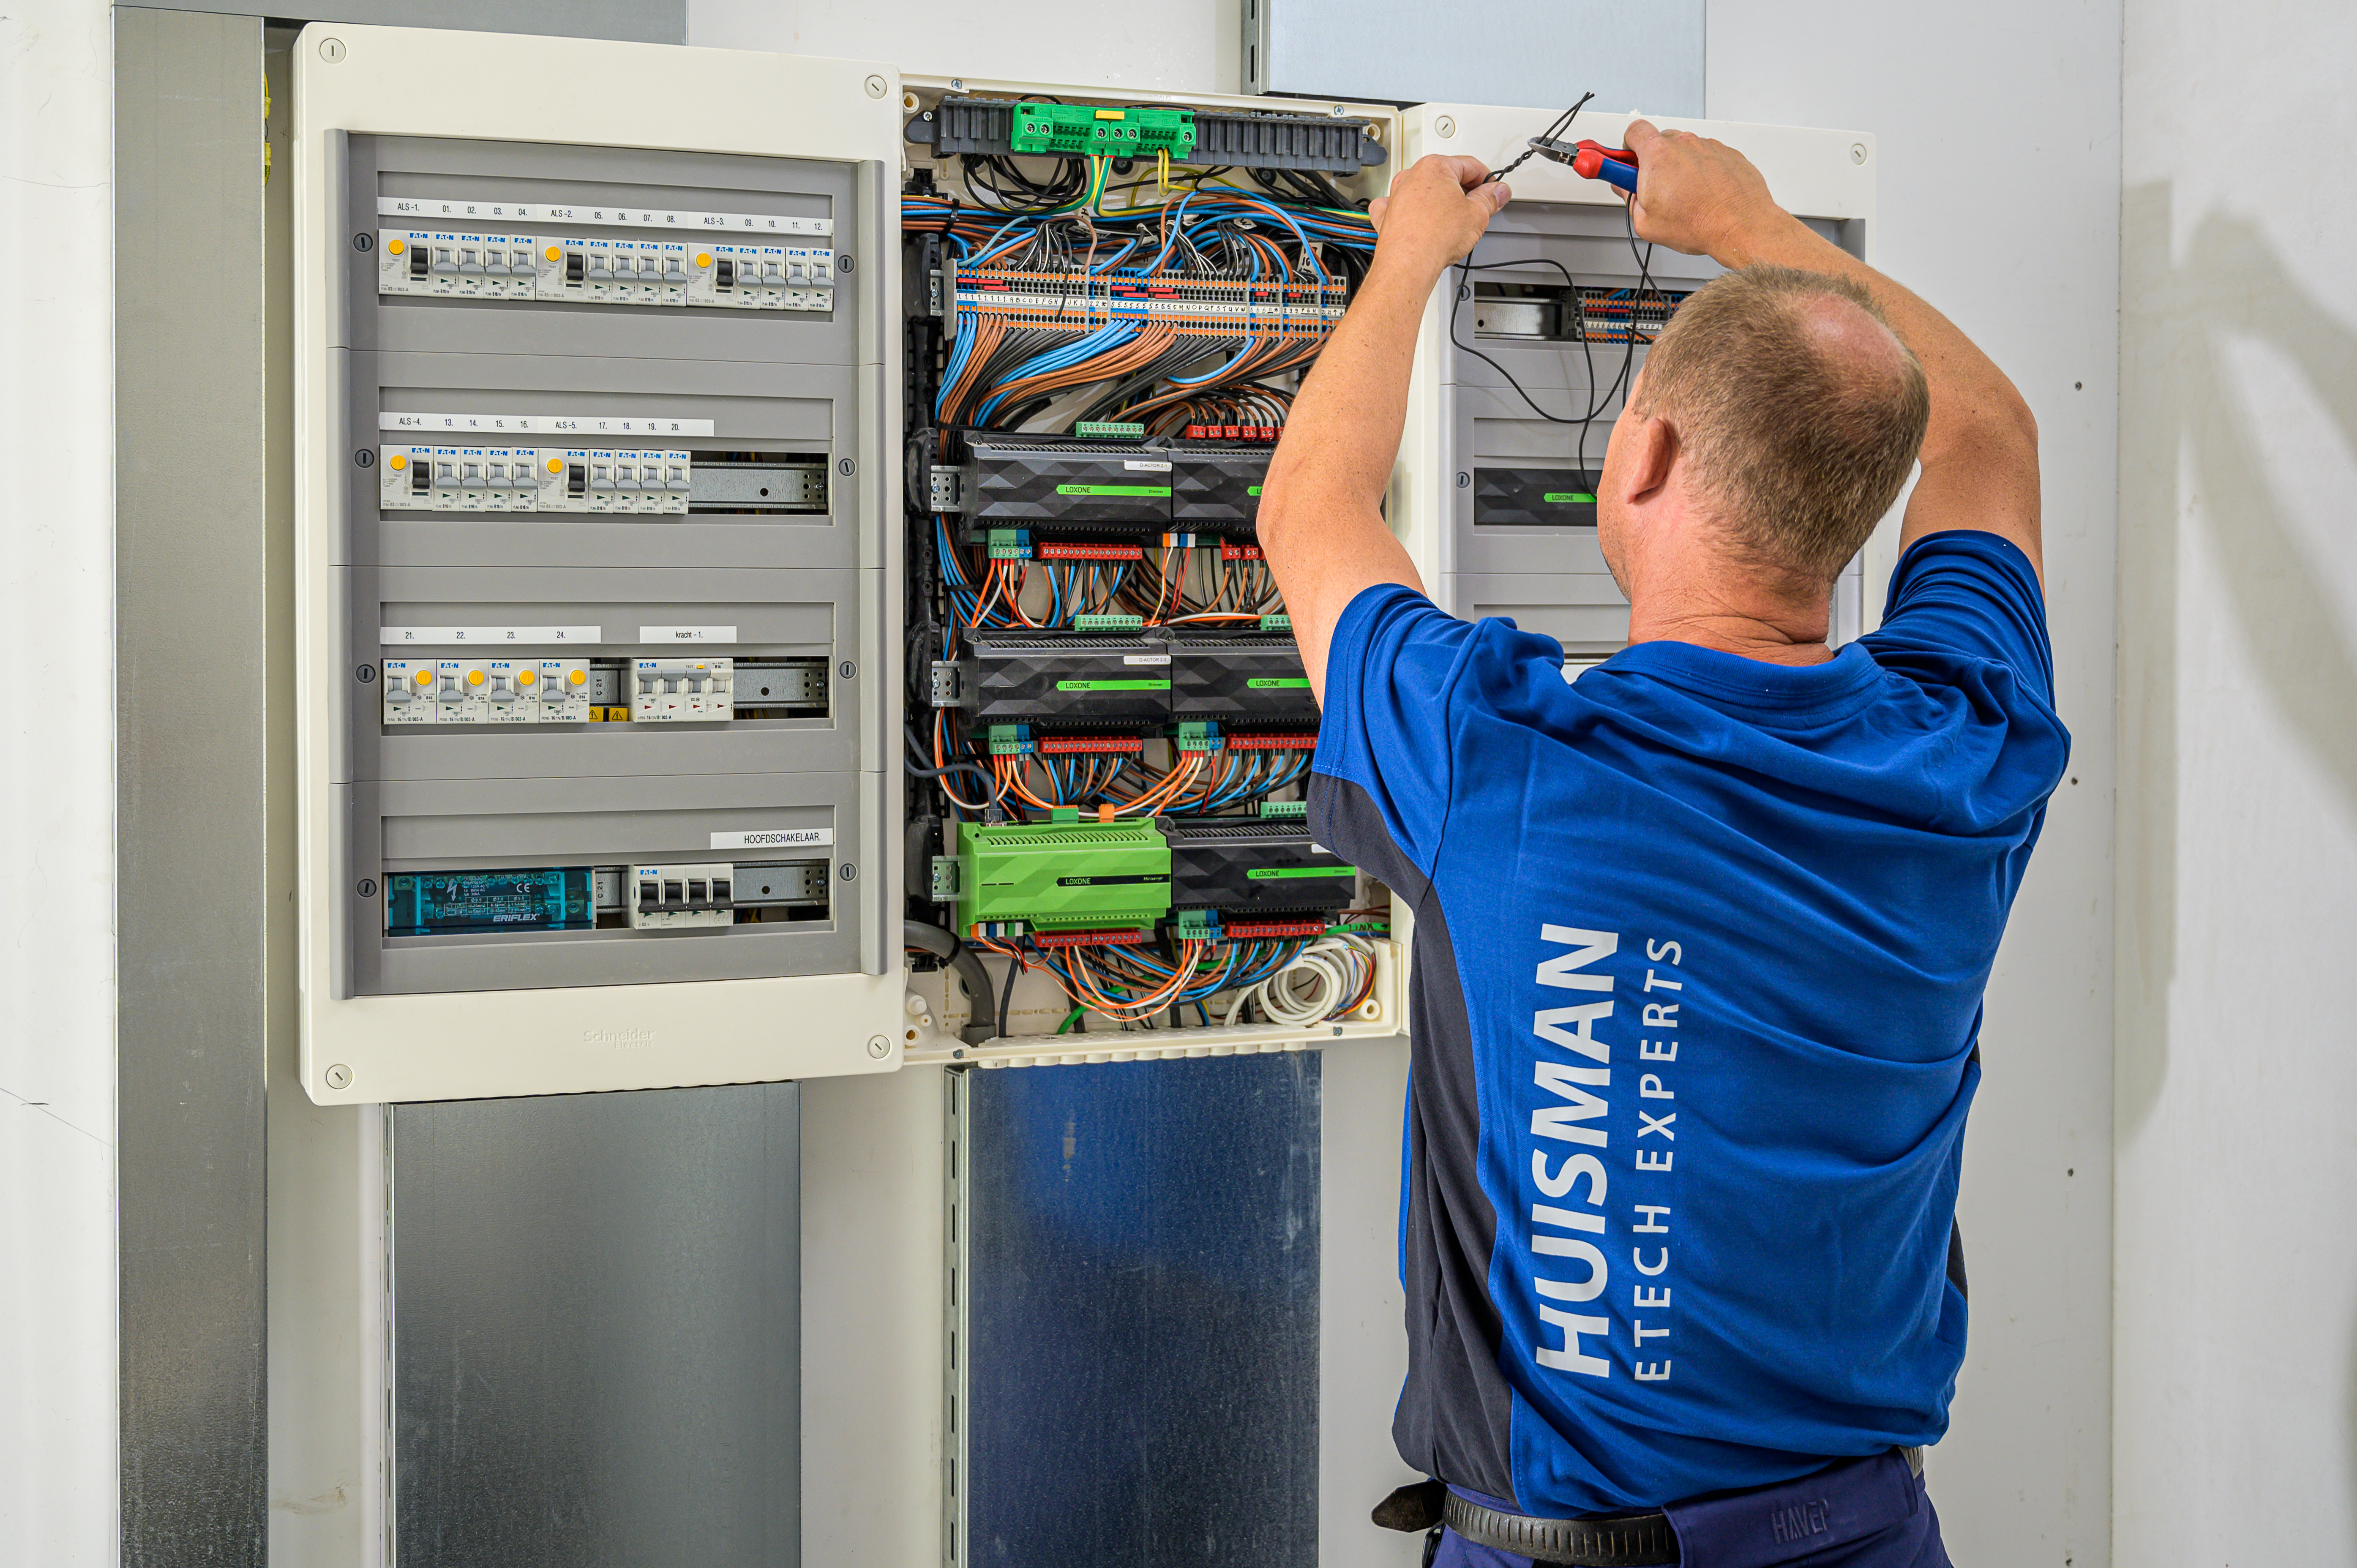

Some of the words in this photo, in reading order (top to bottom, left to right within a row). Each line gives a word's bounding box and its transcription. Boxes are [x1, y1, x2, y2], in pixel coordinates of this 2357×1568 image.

[745, 832, 821, 843] HOOFDSCHAKELAAR.
[1065, 877, 1091, 886] LOXONE
[493, 914, 537, 922] ERIFLEX
[584, 1028, 655, 1043] Schneider
[615, 1040, 654, 1049] Electric
[1635, 937, 1683, 1173] EXPERTS
[1530, 922, 1620, 1379] HUISMAN
[1632, 1204, 1672, 1381] ETECH
